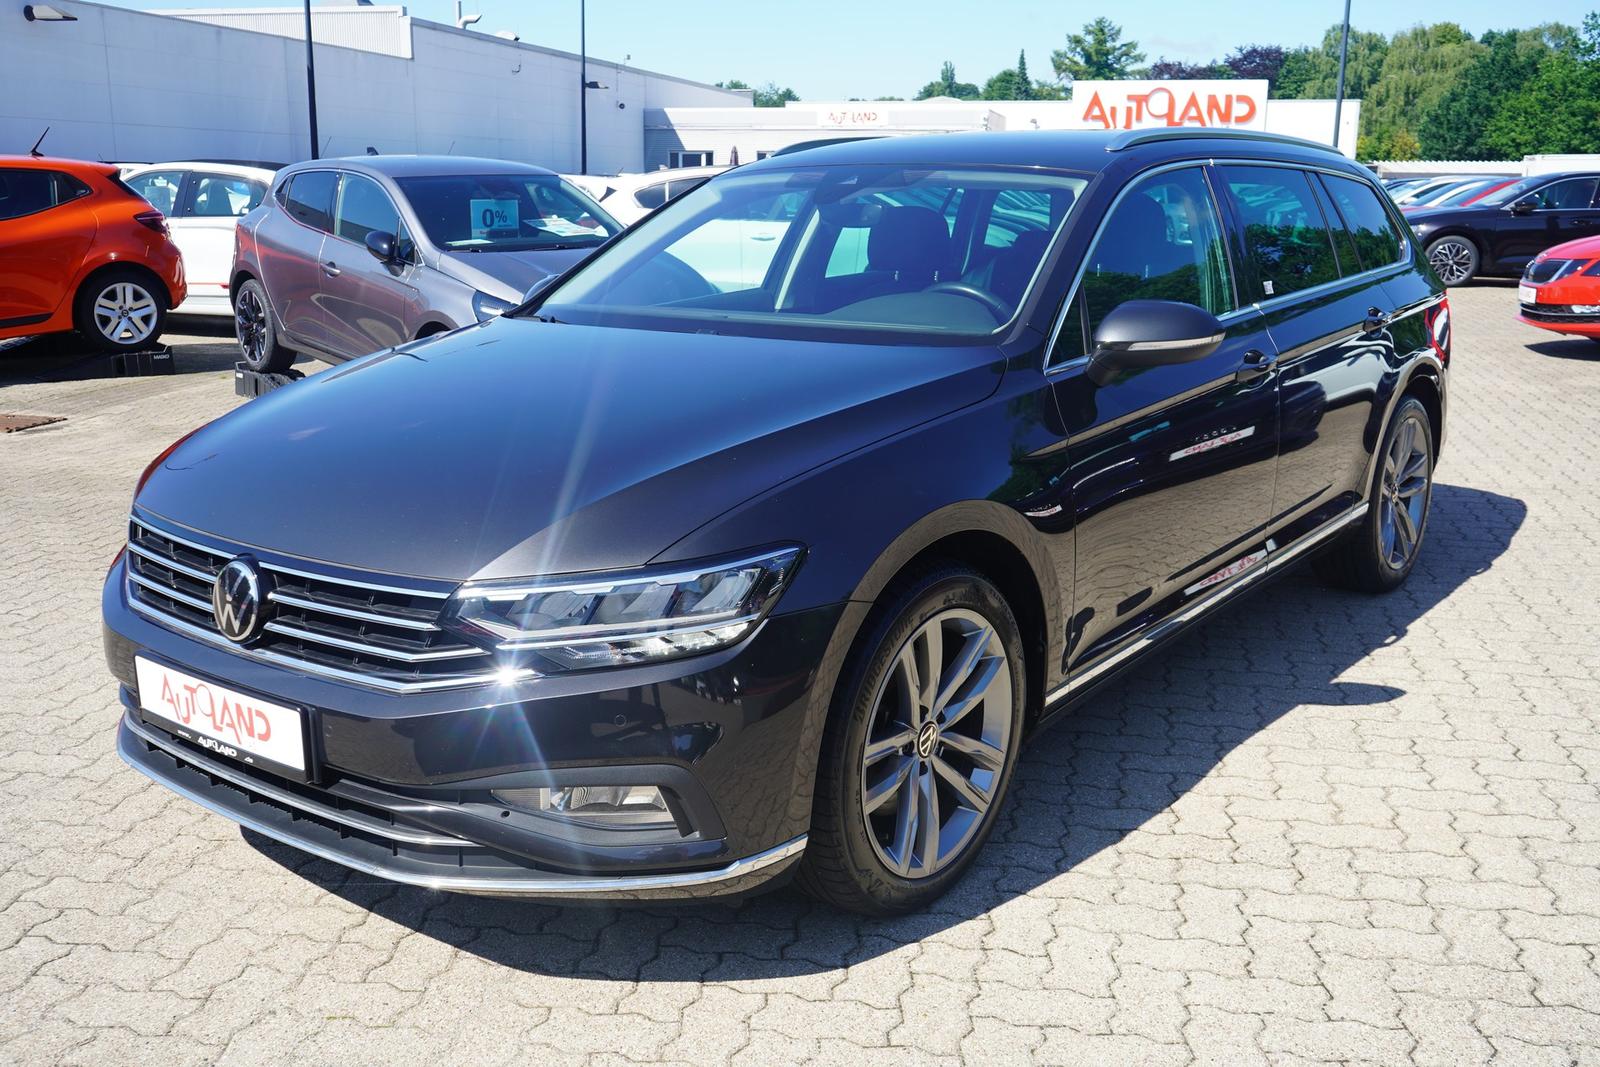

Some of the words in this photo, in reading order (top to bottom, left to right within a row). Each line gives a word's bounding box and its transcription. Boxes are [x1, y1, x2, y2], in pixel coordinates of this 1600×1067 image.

[828, 112, 878, 124] AUTLAND
[1083, 87, 1257, 129] AUTOLAND
[482, 208, 508, 228] 0%
[162, 673, 272, 745] AUTOLAND
[197, 736, 238, 757] AUTOLAND
